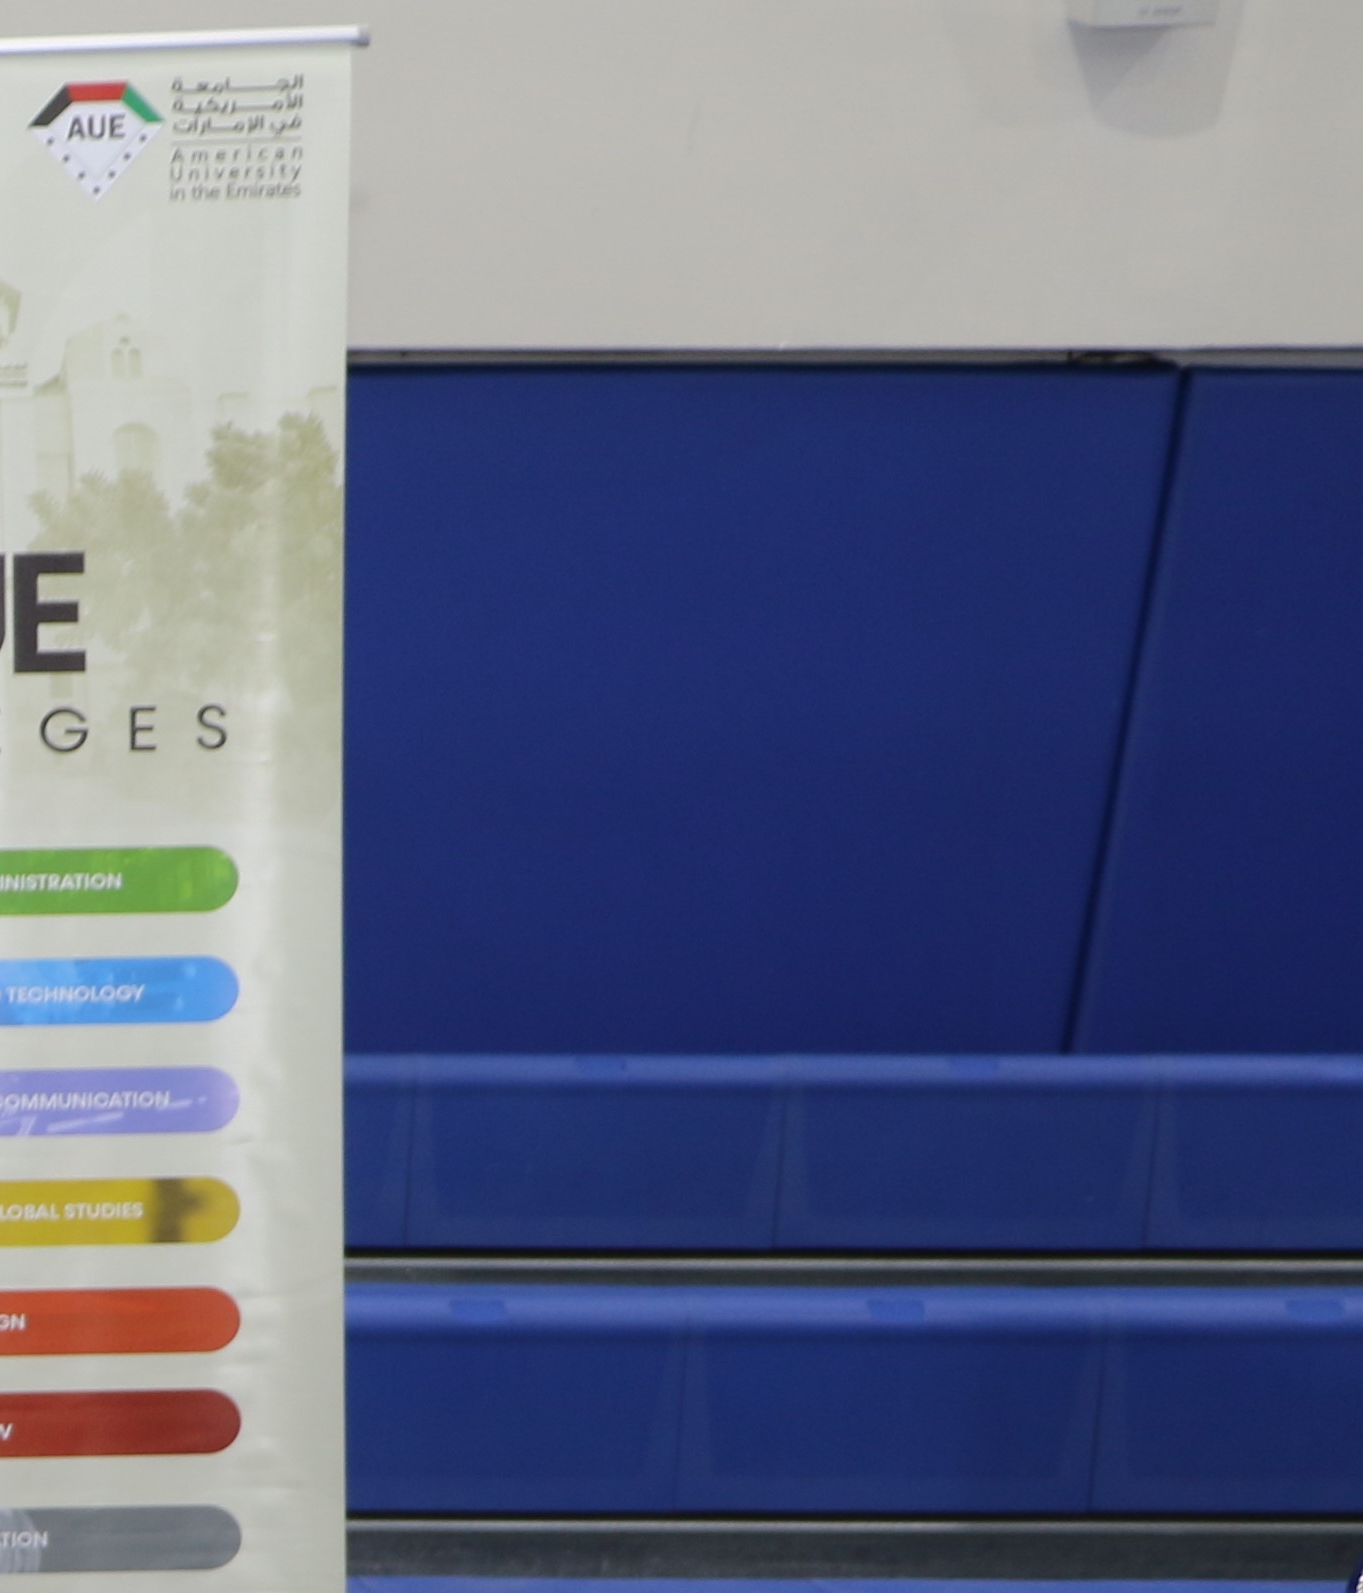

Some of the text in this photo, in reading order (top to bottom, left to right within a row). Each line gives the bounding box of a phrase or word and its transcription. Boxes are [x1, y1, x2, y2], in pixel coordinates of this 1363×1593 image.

[67, 114, 126, 142] AUE
[271, 114, 302, 136] في
[171, 146, 304, 164] American
[171, 164, 302, 182] University
[171, 180, 303, 201] in the Emirates
[6, 982, 145, 1004] TECHNOLOGY
[63, 1200, 144, 1220] STUDIES
